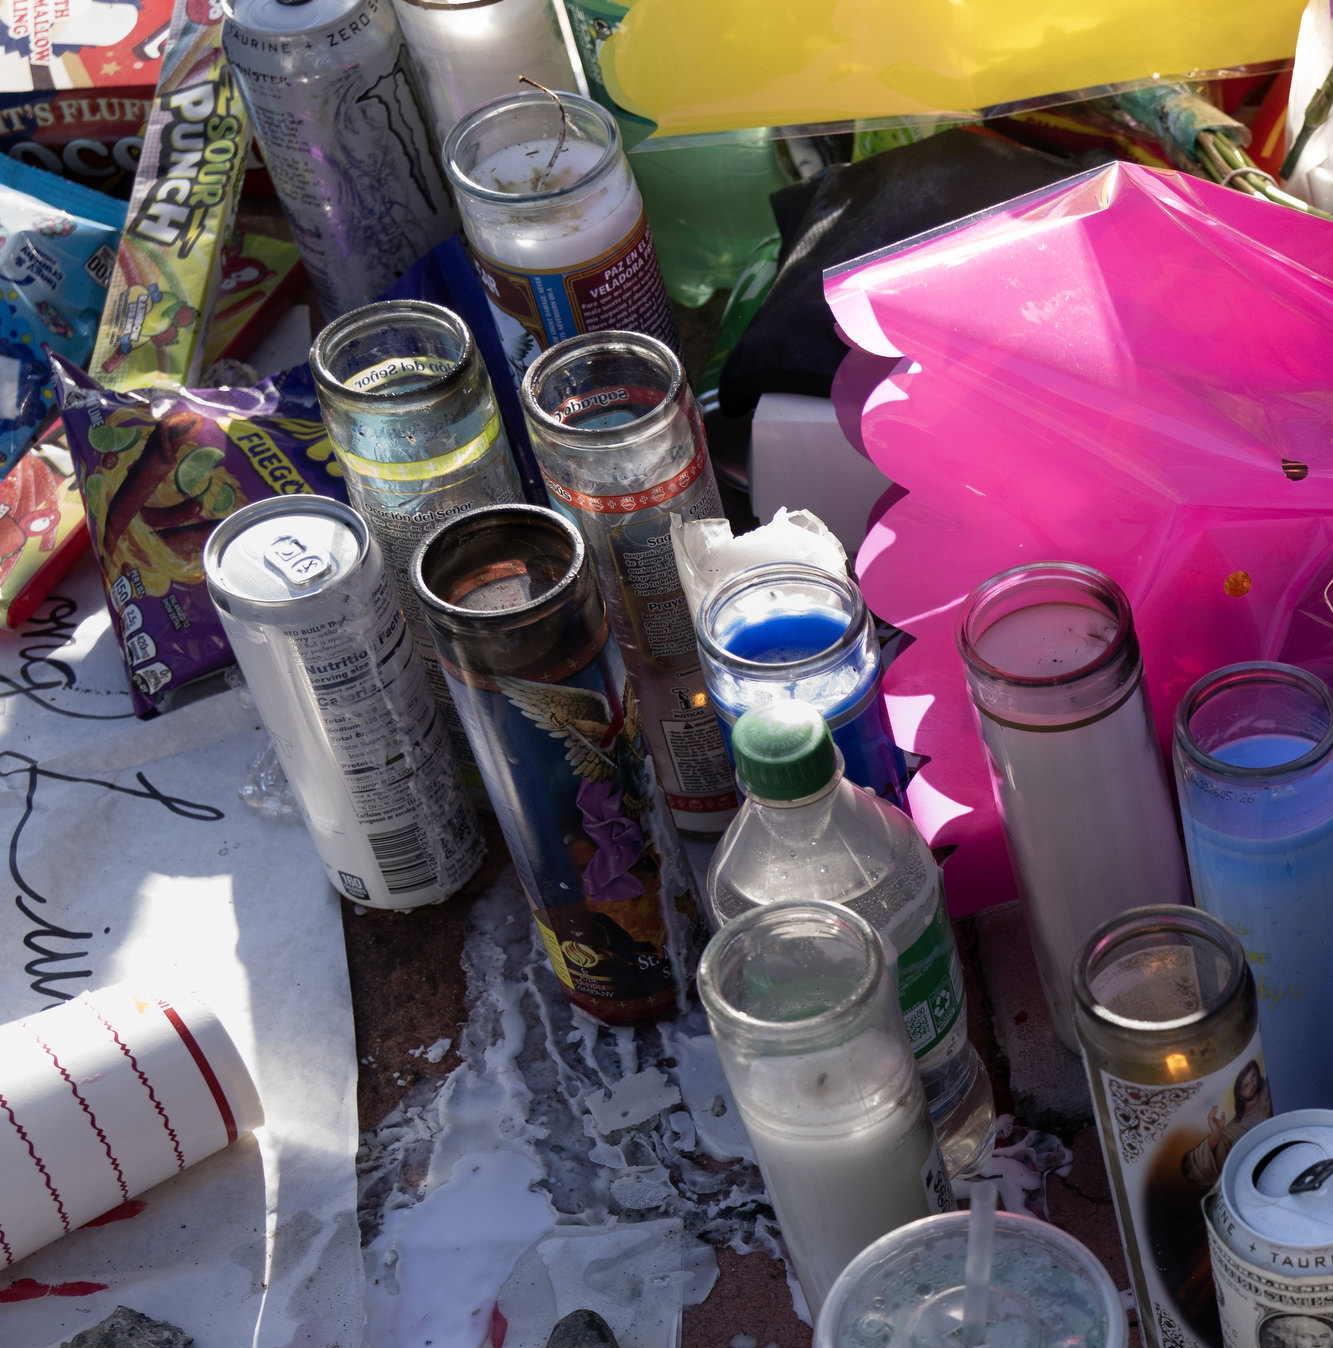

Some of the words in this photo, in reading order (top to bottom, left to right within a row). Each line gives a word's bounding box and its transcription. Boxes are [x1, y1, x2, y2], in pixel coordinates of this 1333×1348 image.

[229, 26, 290, 54] TAURINE
[326, 12, 371, 48] ZERO
[140, 81, 216, 243] PUNCH
[191, 116, 239, 206] SOUR
[590, 258, 644, 298] VELADORA
[604, 260, 625, 281] PAZ
[626, 250, 638, 267] EN
[237, 432, 304, 496] FUEGO
[364, 503, 411, 523] Oración
[412, 511, 435, 523] del
[436, 499, 474, 520] Señor
[112, 578, 131, 602] 150
[341, 873, 362, 889] 160
[637, 954, 660, 970] St.
